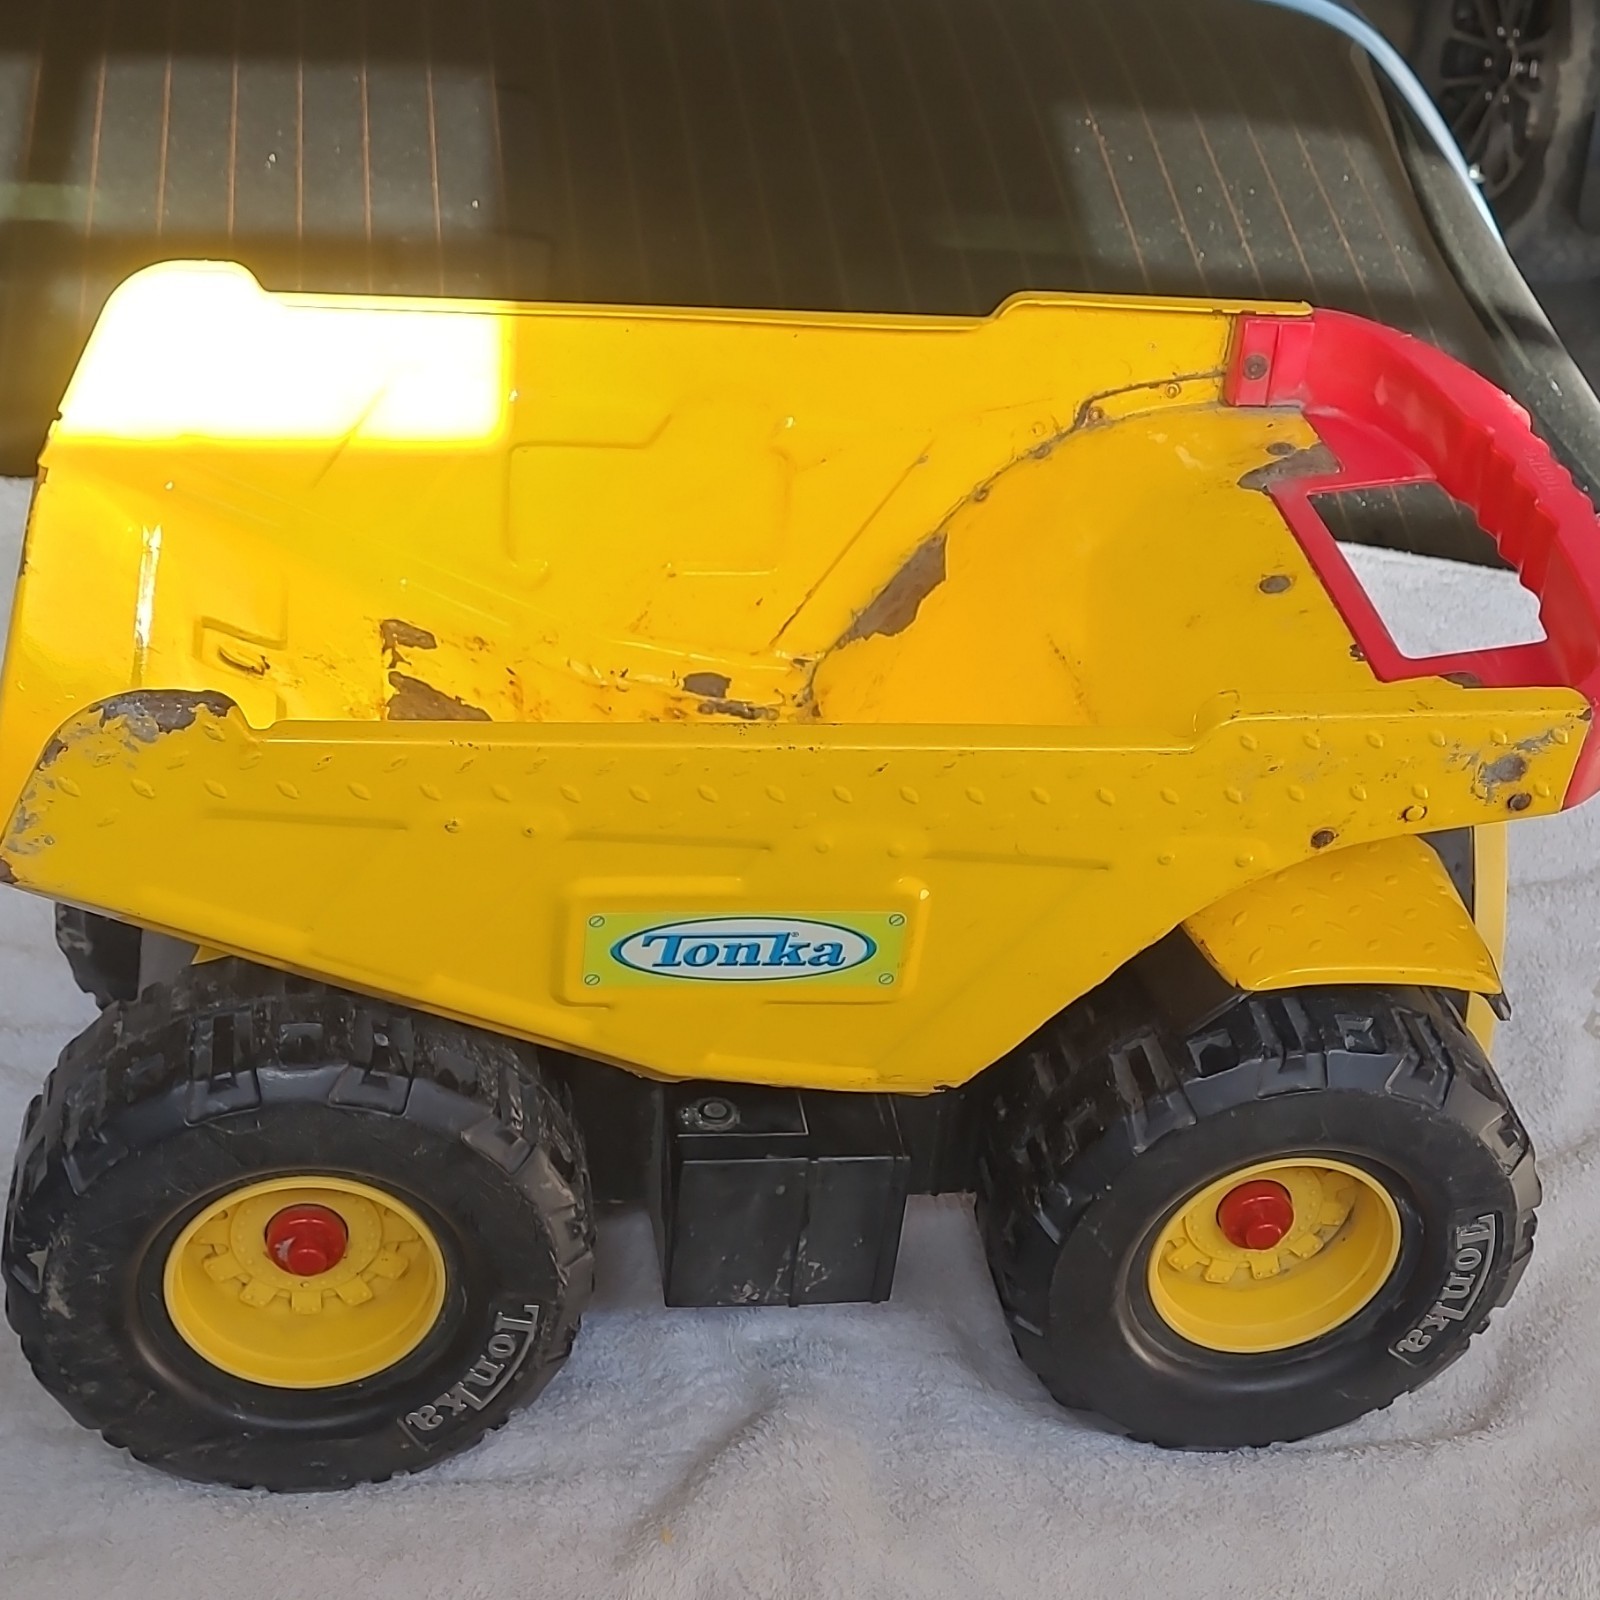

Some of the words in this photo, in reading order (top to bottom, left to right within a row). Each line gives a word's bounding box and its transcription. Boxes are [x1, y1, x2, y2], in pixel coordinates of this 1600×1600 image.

[641, 931, 846, 967] Tonka
[1395, 1213, 1495, 1353] Tonka
[405, 1304, 540, 1431] Tonka
